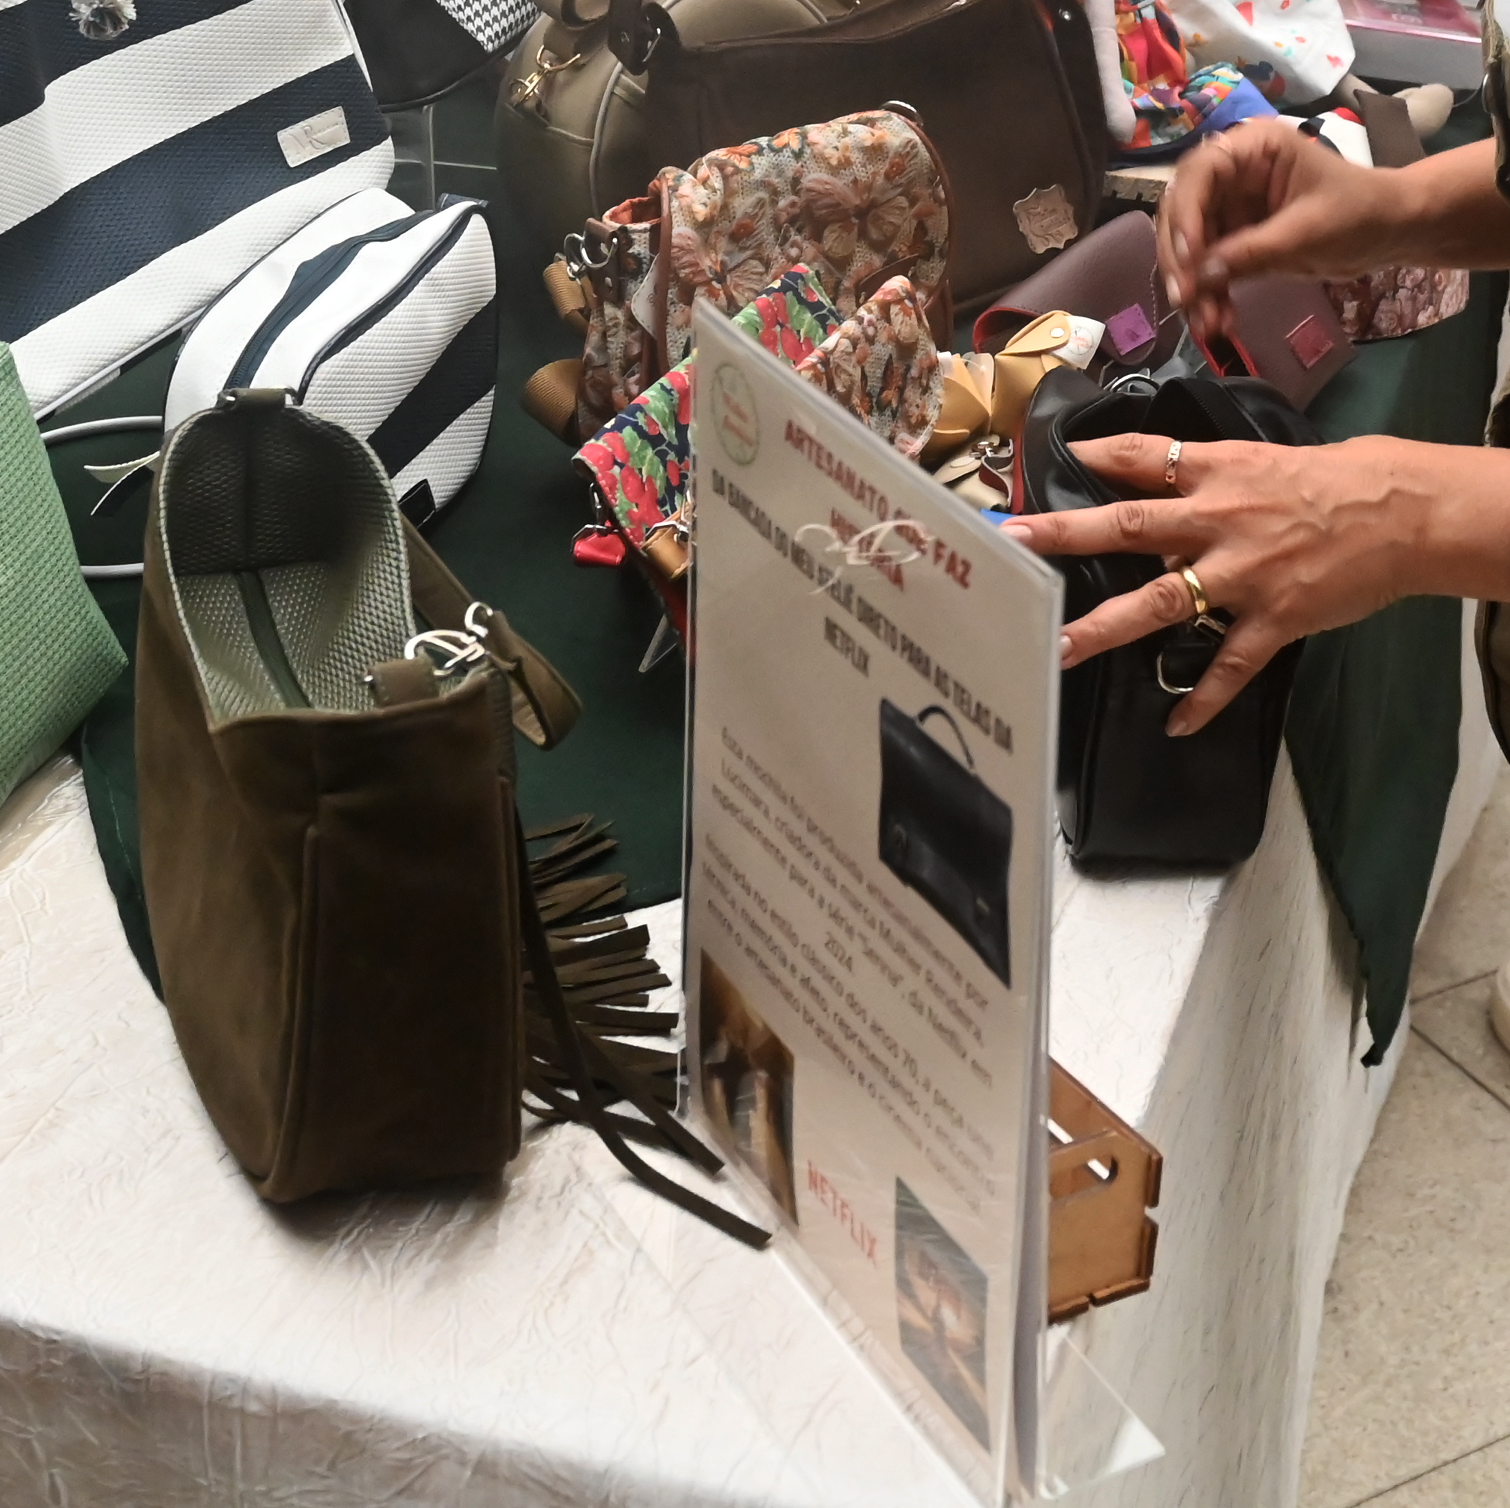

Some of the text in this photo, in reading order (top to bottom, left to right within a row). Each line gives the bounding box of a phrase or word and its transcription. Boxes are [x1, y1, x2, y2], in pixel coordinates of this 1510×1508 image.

[784, 419, 888, 520] ARTESANATO
[932, 540, 973, 592] FAZ
[824, 614, 870, 679] NETFLIX
[807, 1156, 877, 1269] NETFLIX
